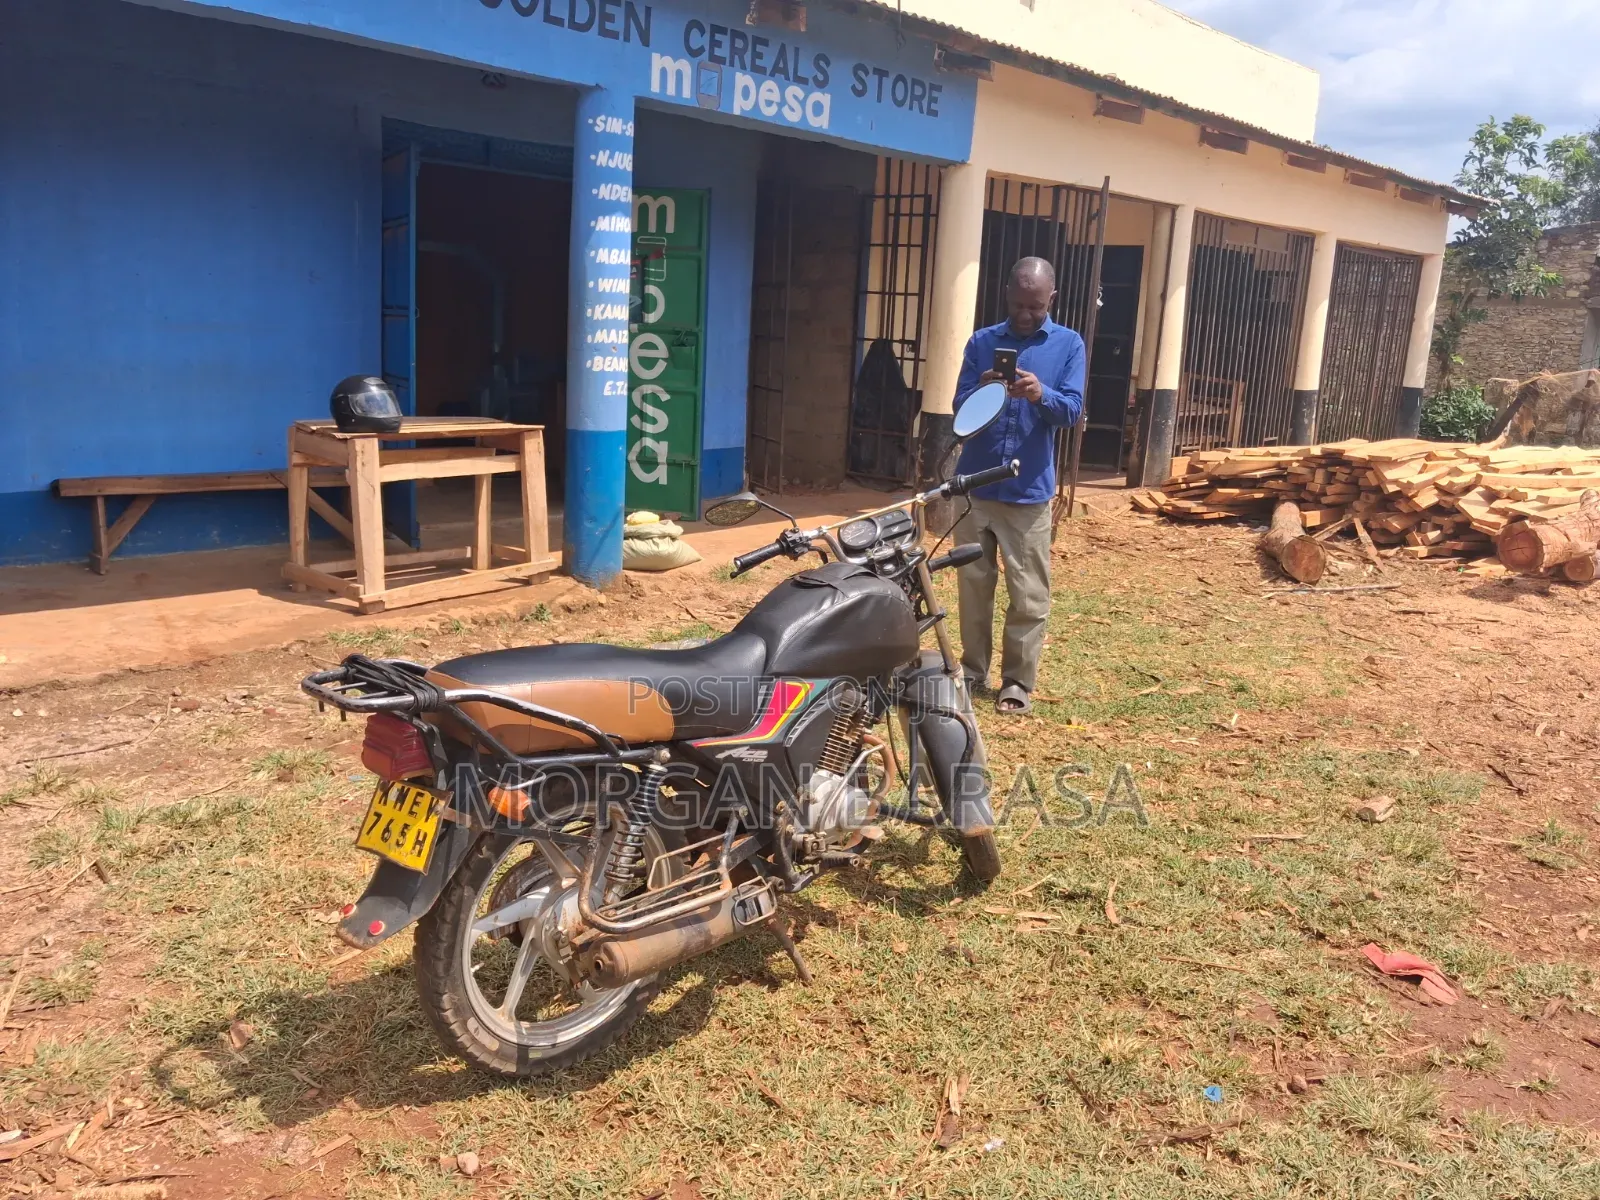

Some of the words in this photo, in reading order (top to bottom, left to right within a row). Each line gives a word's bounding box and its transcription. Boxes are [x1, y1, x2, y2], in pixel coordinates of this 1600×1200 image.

[479, 0, 652, 48] LDEN
[684, 19, 831, 89] CEREALS
[850, 63, 943, 118] STORE
[733, 71, 831, 129] pesa
[366, 811, 427, 858] 765H
